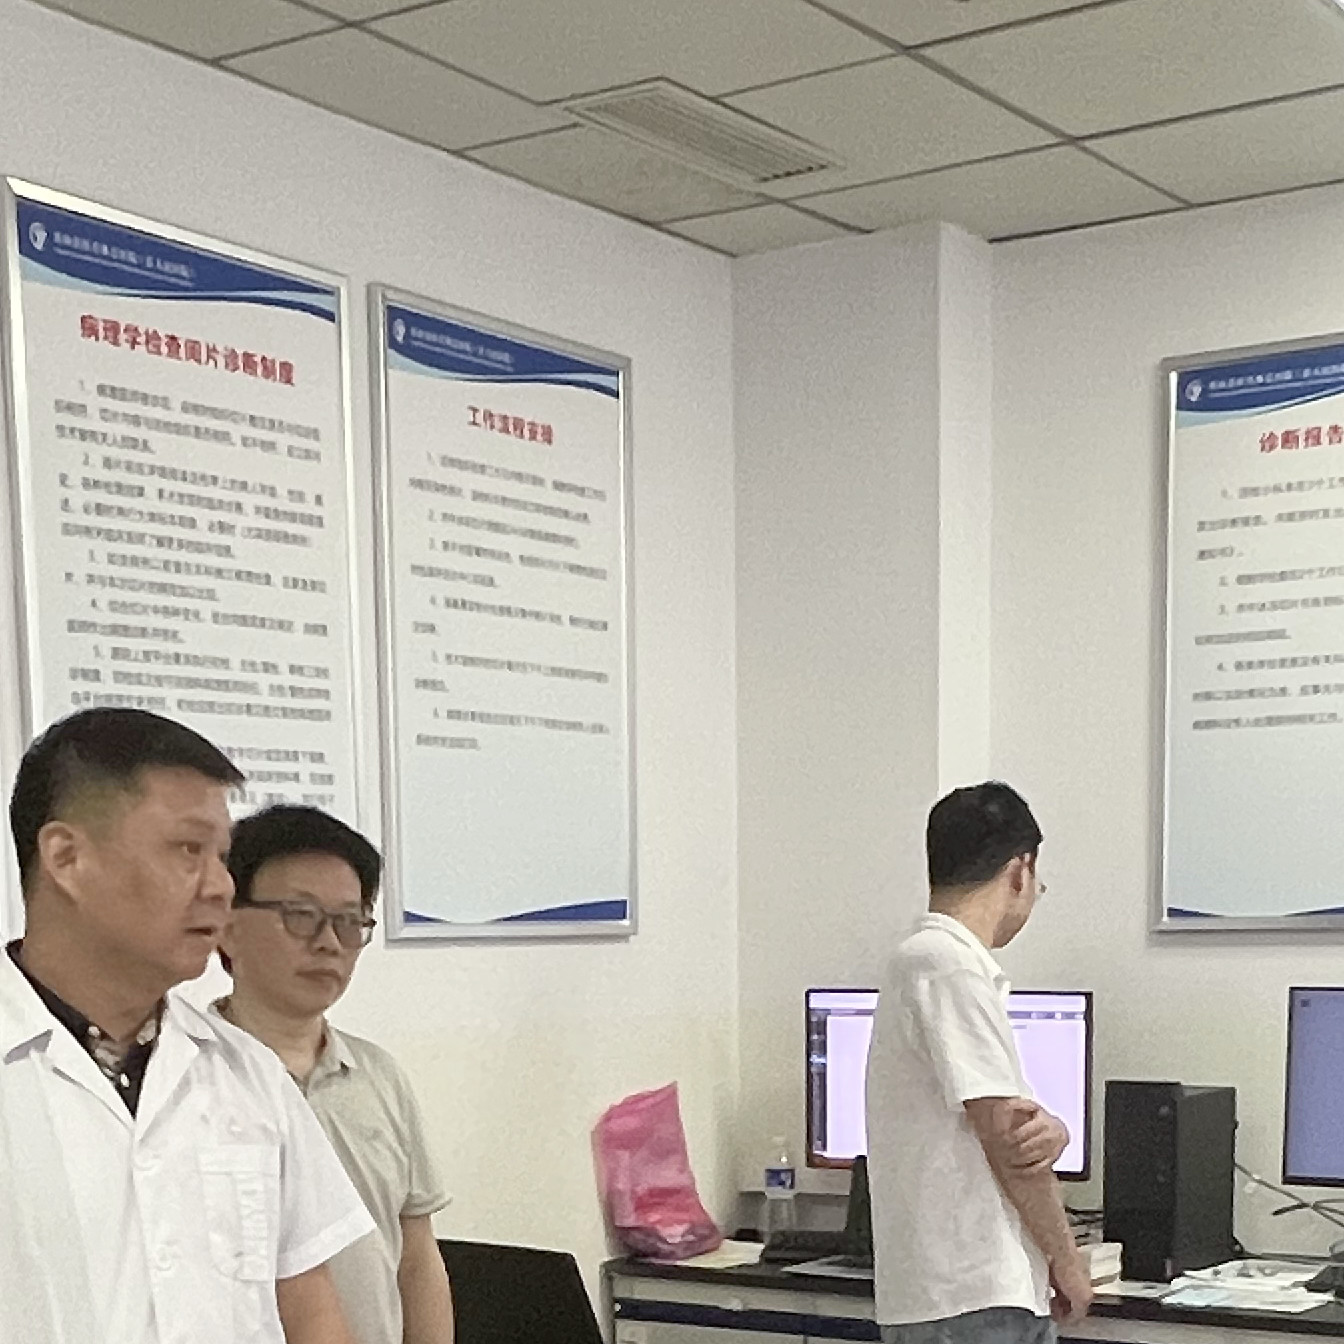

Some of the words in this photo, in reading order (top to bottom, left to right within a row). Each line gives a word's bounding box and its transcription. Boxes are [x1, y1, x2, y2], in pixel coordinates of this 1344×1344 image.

[80, 314, 295, 386] 病理学检查阅片诊断制度
